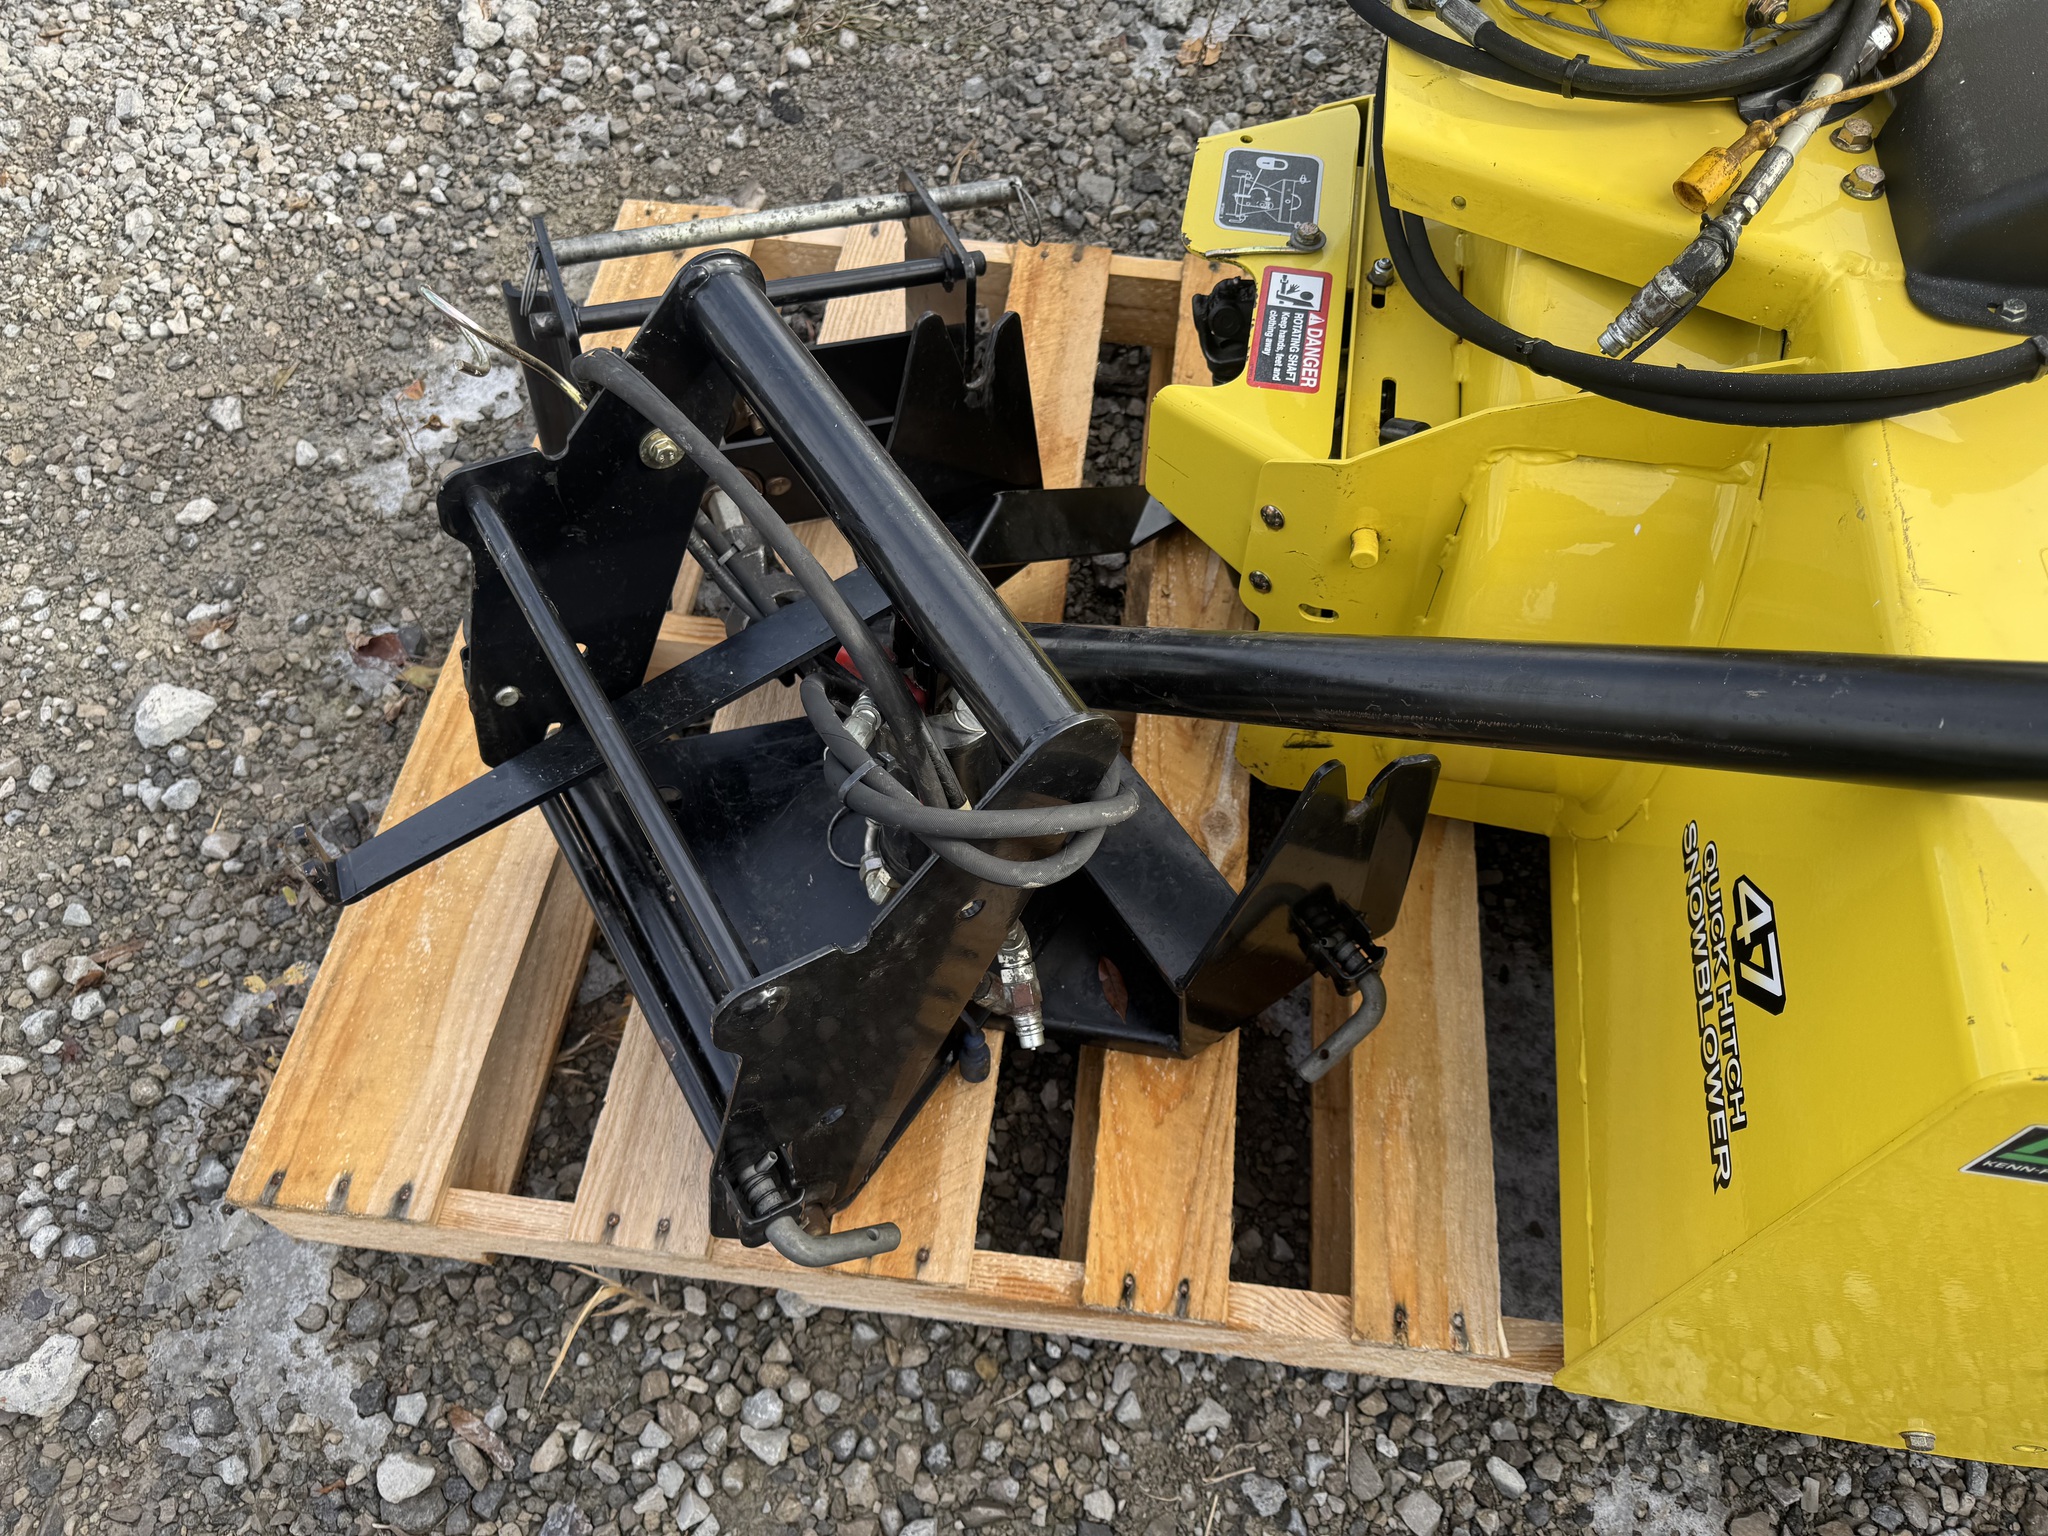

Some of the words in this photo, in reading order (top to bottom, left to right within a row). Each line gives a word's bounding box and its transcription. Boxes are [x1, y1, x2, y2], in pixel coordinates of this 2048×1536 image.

[1265, 310, 1278, 337] clothing
[1278, 311, 1290, 329] Keep
[1289, 312, 1304, 353] ROTATING
[1262, 338, 1272, 356] away
[1275, 329, 1288, 352] hands,
[1274, 353, 1285, 367] feet
[1285, 354, 1299, 383] SHAFT
[1300, 328, 1323, 388] DANGER
[1272, 367, 1282, 381] and
[1703, 841, 1731, 978] QUICK
[1733, 877, 1785, 1009] 47
[1682, 821, 1731, 1194] SNOWBLOWER
[1716, 984, 1747, 1131] HITCH
